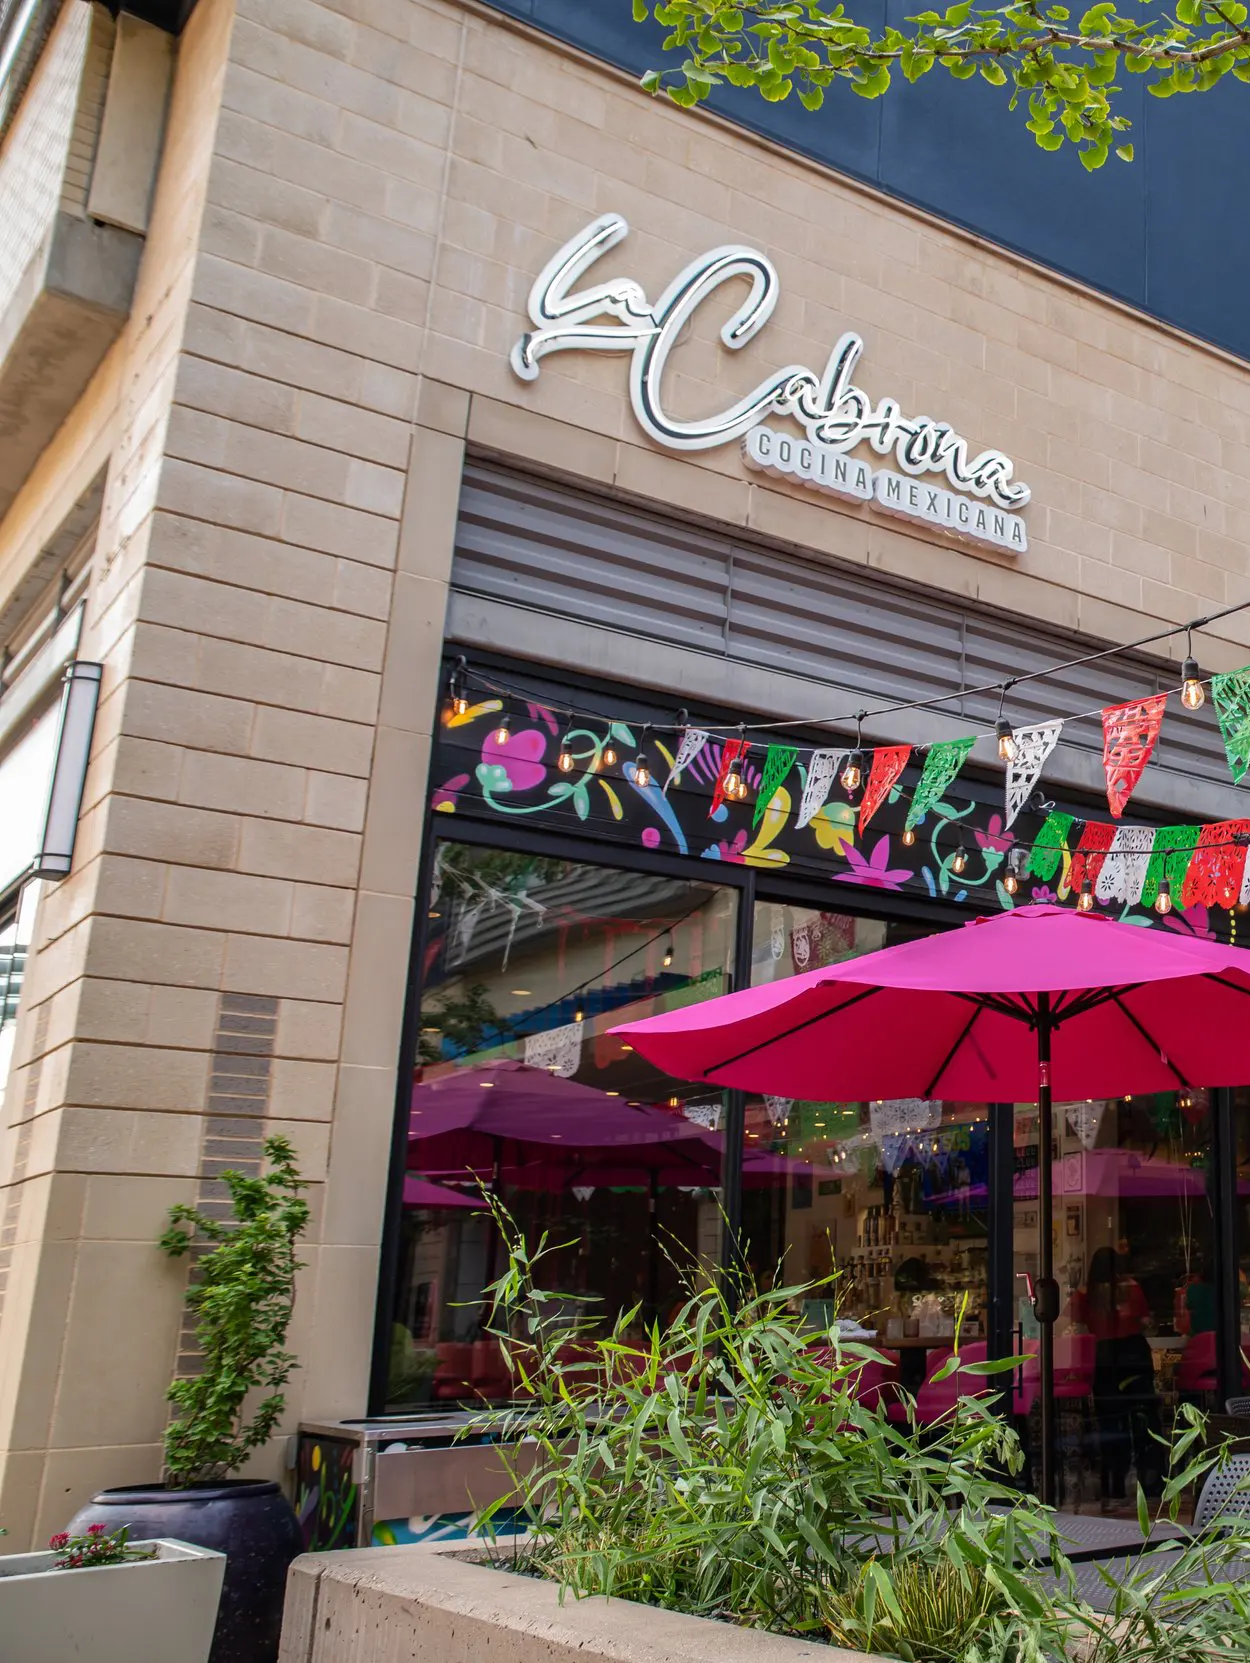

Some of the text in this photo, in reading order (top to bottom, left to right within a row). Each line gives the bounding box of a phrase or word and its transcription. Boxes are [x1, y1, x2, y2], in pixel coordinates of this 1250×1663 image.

[510, 212, 1032, 509] La Cabrona
[757, 432, 1023, 544] COCINA MEXICANA
